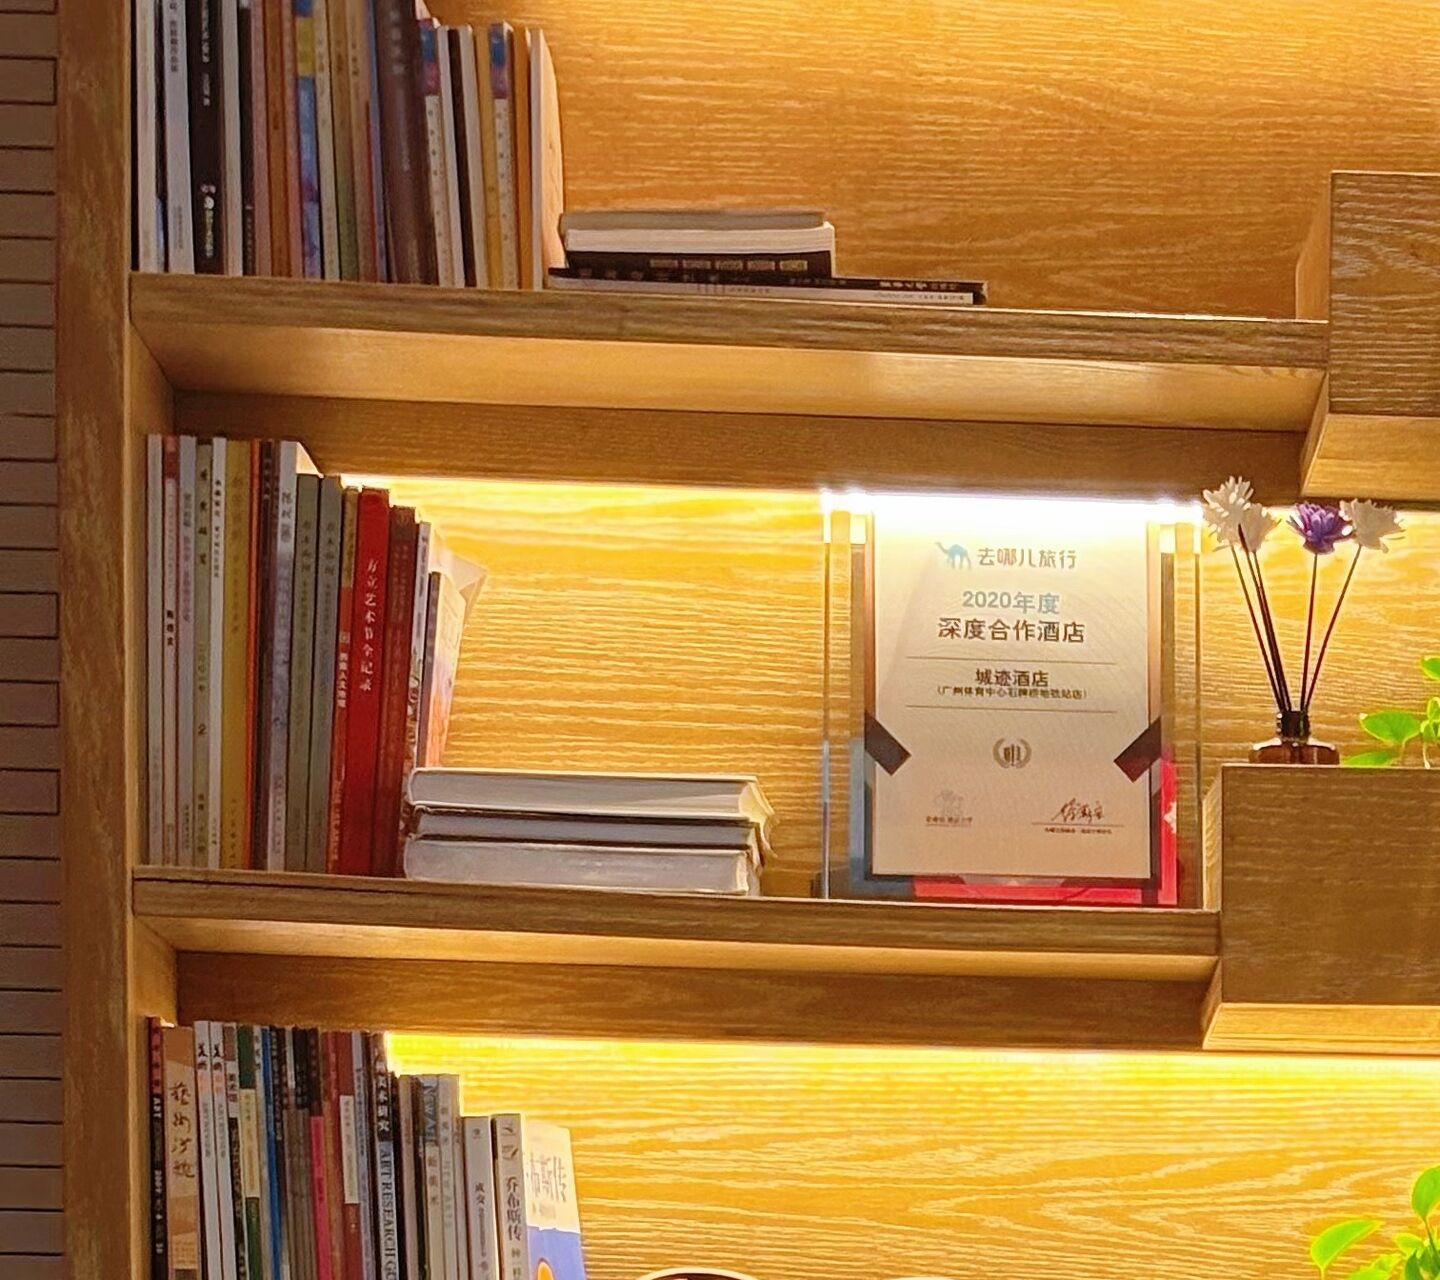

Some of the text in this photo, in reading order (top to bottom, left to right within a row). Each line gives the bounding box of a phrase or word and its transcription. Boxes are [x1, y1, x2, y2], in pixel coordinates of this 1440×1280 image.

[977, 547, 1077, 570] 去哪儿旅行
[962, 590, 1060, 615] 2020年度
[938, 618, 1086, 644] 深度合作酒店
[526, 1153, 569, 1205] 布斯传
[506, 1176, 523, 1242] 乔布斯传
